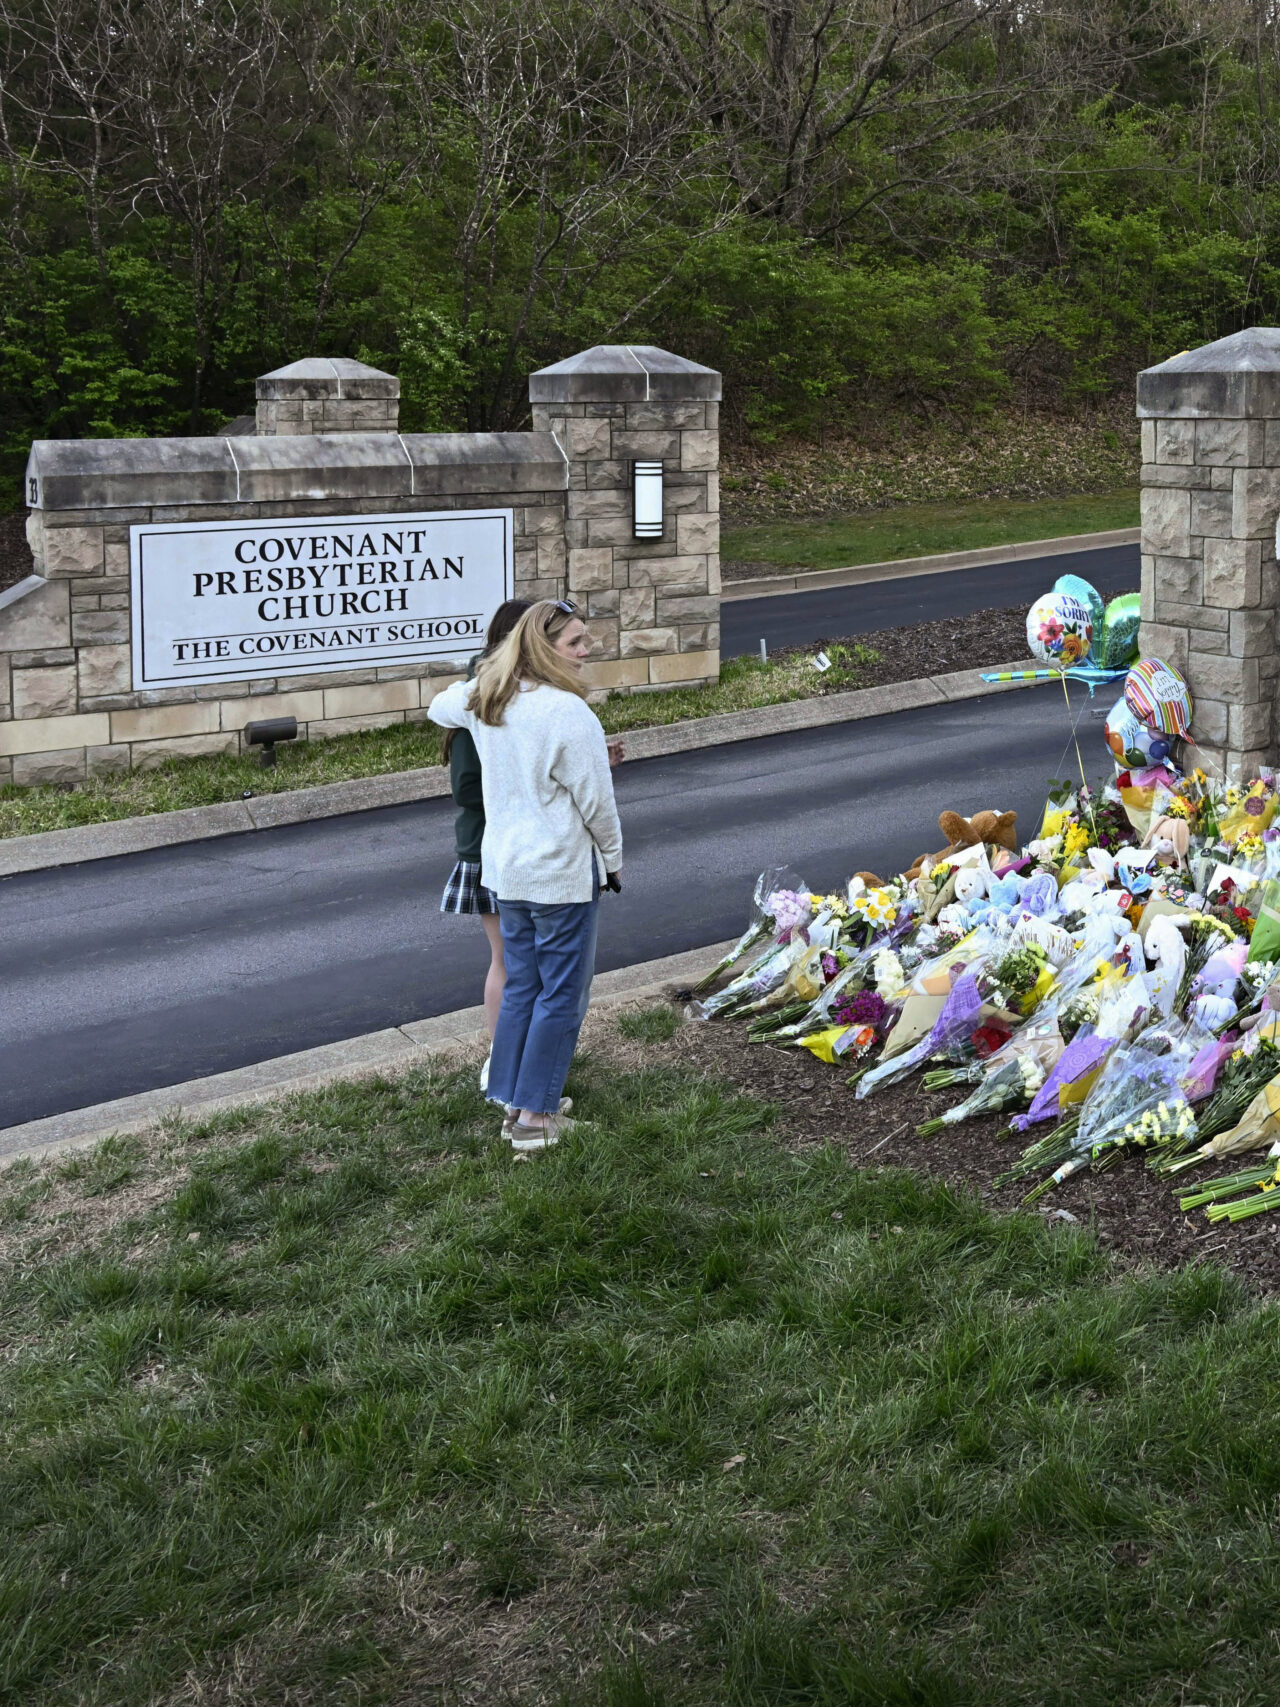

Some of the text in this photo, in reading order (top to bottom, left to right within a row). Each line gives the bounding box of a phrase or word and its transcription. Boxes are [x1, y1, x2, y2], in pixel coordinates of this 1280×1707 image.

[234, 530, 427, 564] COVENANT
[192, 555, 465, 598] PRESBYTERIAN
[257, 587, 410, 622] CHURCH
[1055, 606, 1090, 622] SORRY
[1061, 595, 1080, 607] I'M
[173, 618, 484, 661] THE COVENANT SCHOOL
[1154, 675, 1170, 687] I'm
